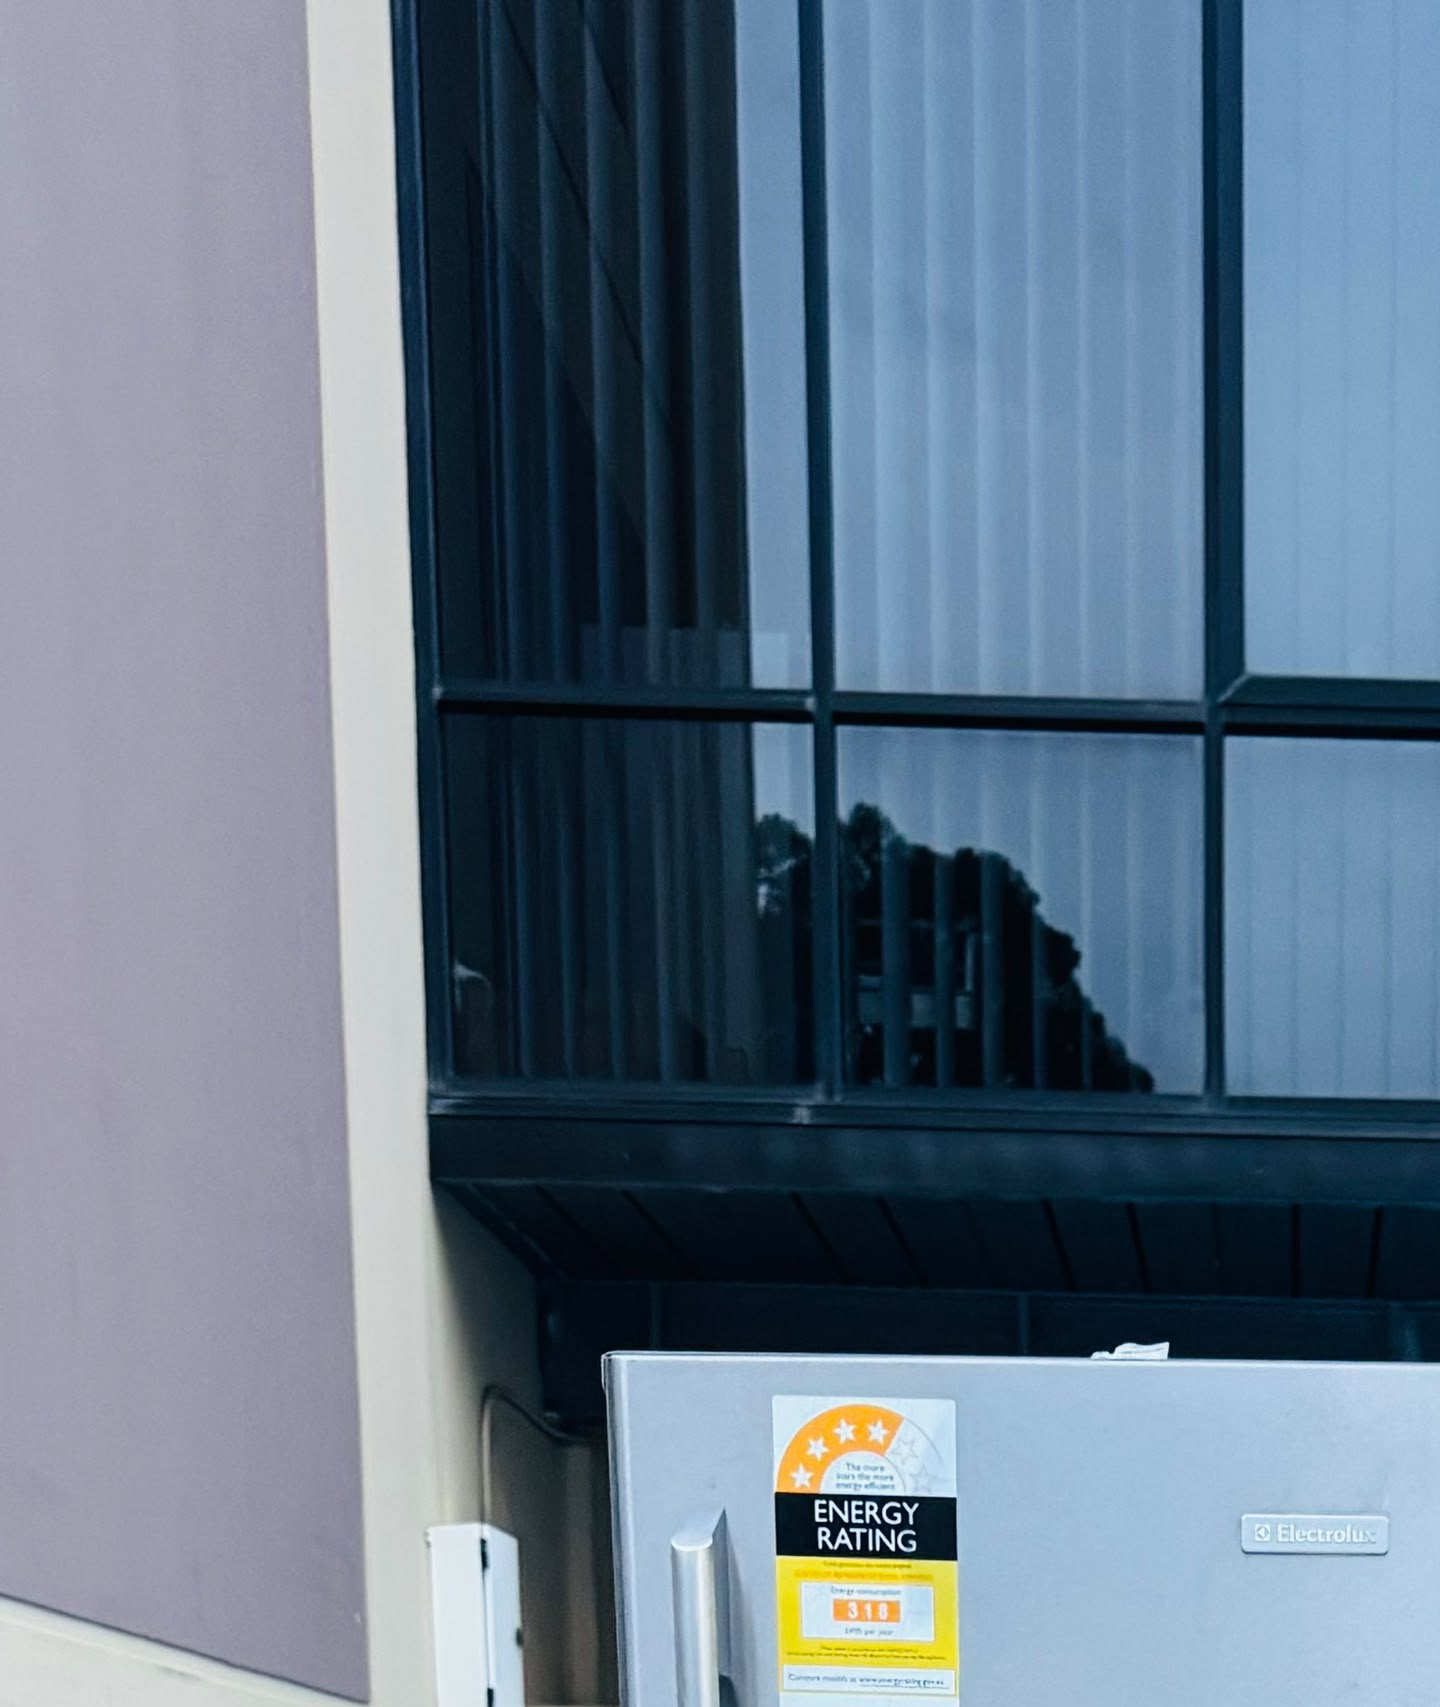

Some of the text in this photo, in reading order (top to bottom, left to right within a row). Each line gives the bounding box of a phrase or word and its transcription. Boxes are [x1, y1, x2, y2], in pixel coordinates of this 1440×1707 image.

[814, 1499, 919, 1526] ENERGY
[817, 1526, 917, 1553] RATING
[1277, 1523, 1377, 1544] Electrolux
